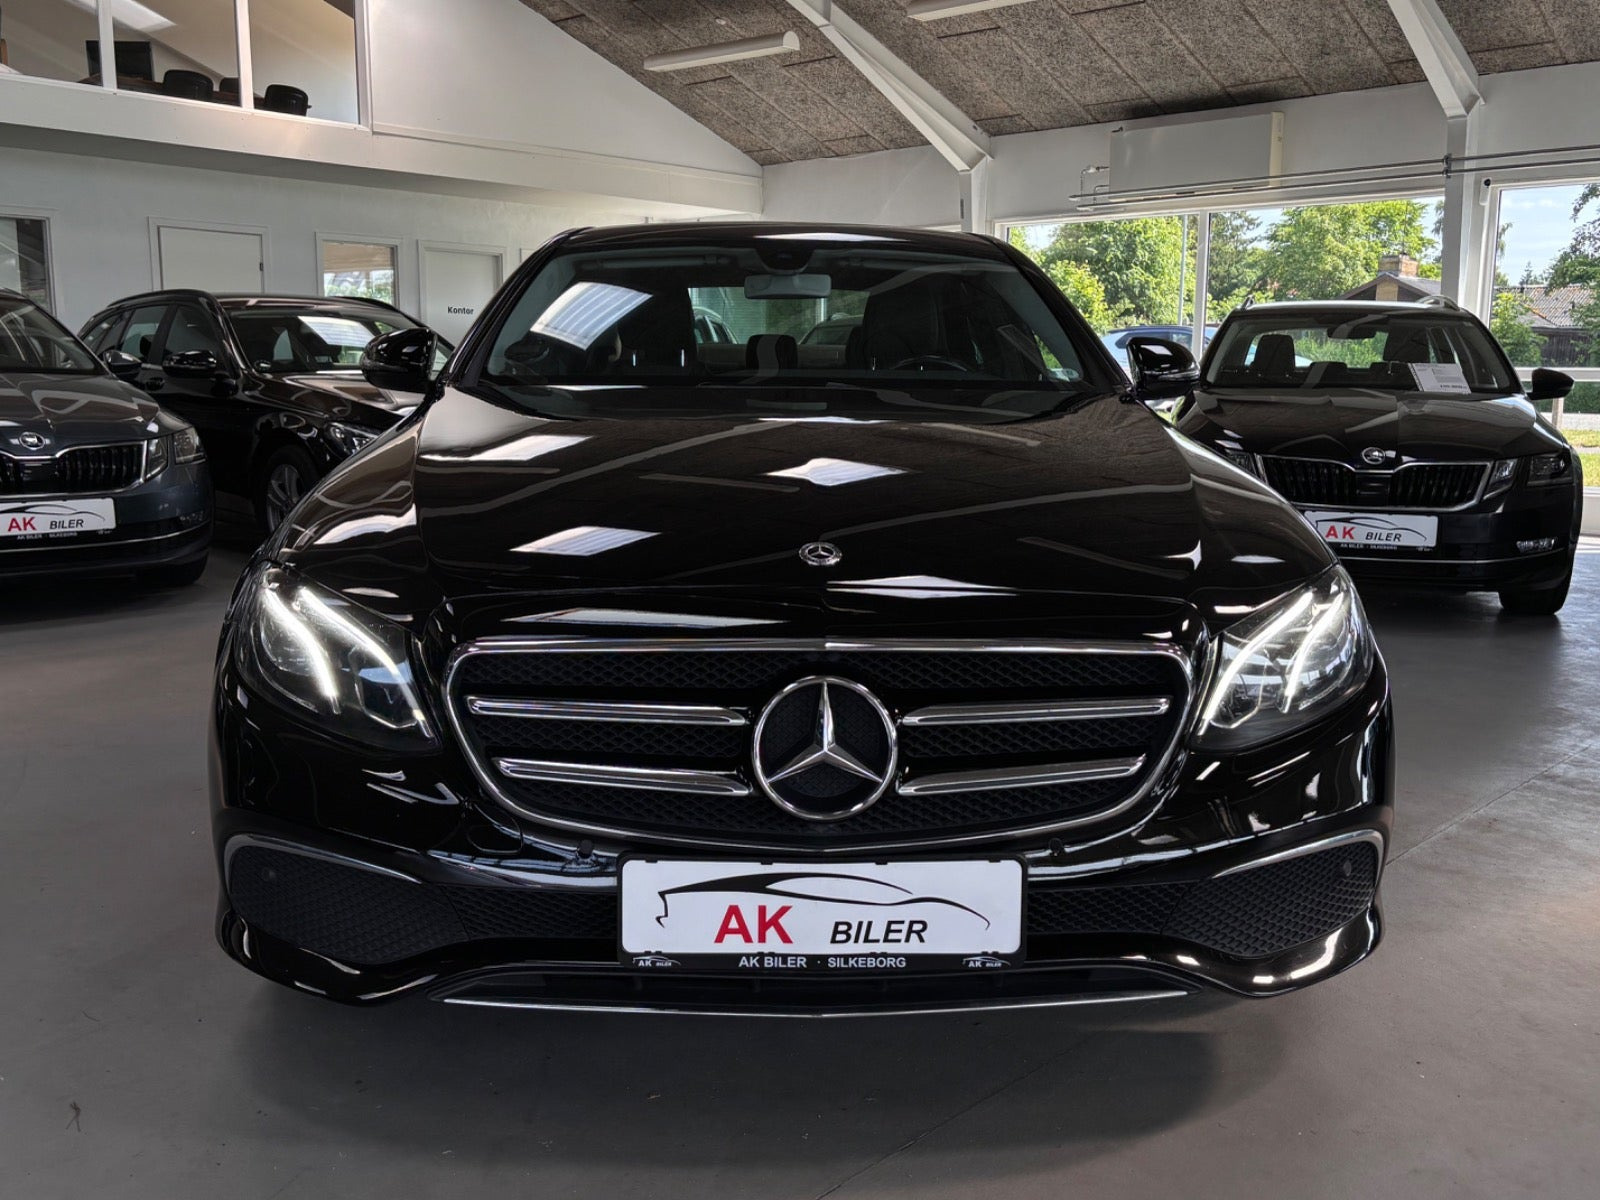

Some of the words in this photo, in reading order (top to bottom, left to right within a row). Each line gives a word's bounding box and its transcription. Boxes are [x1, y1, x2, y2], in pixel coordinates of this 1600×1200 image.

[448, 306, 474, 315] Kontor
[8, 516, 37, 532] AK
[49, 519, 84, 530] BILER
[1325, 525, 1356, 540] AK
[1365, 532, 1402, 542] BILER
[714, 905, 793, 944] AK
[829, 920, 928, 944] BILER
[739, 956, 760, 968] AK
[764, 956, 807, 968] BILER
[827, 956, 907, 968] SILKEBORG
